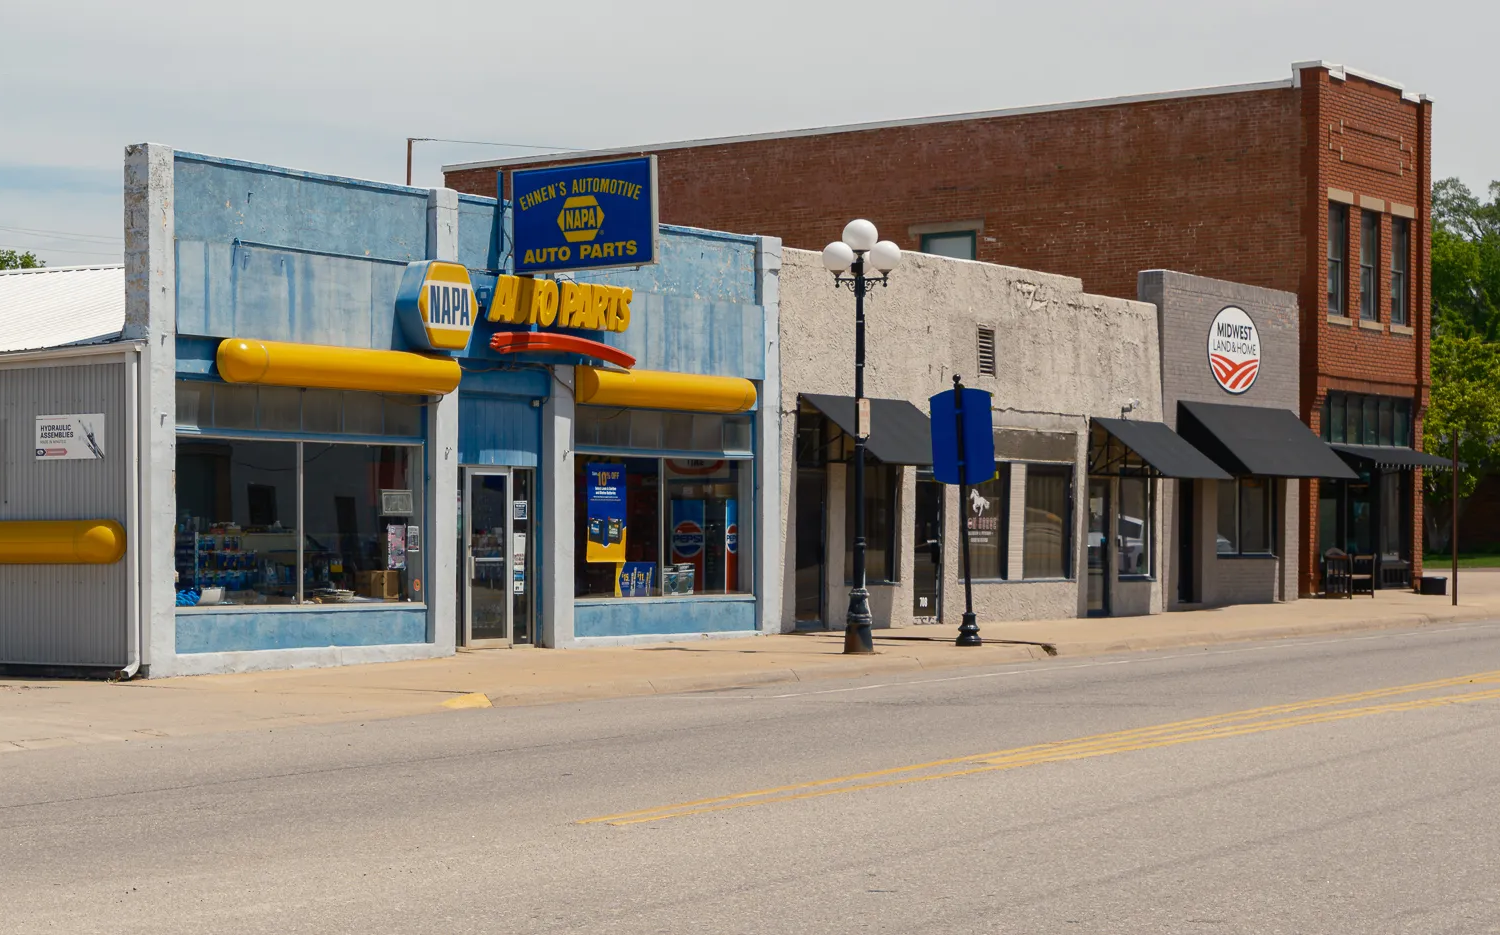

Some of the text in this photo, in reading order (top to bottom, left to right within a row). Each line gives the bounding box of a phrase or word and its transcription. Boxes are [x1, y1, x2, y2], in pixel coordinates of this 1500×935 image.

[519, 177, 643, 211] EHNEN'S AUTOMOTIVE
[565, 208, 597, 230] NAPA
[523, 240, 638, 264] AUTO PARTS
[430, 285, 470, 326] NAPA
[487, 273, 634, 333] AUTO PARTS
[1217, 322, 1252, 341] MIDWEST
[673, 535, 703, 543] PEPSI
